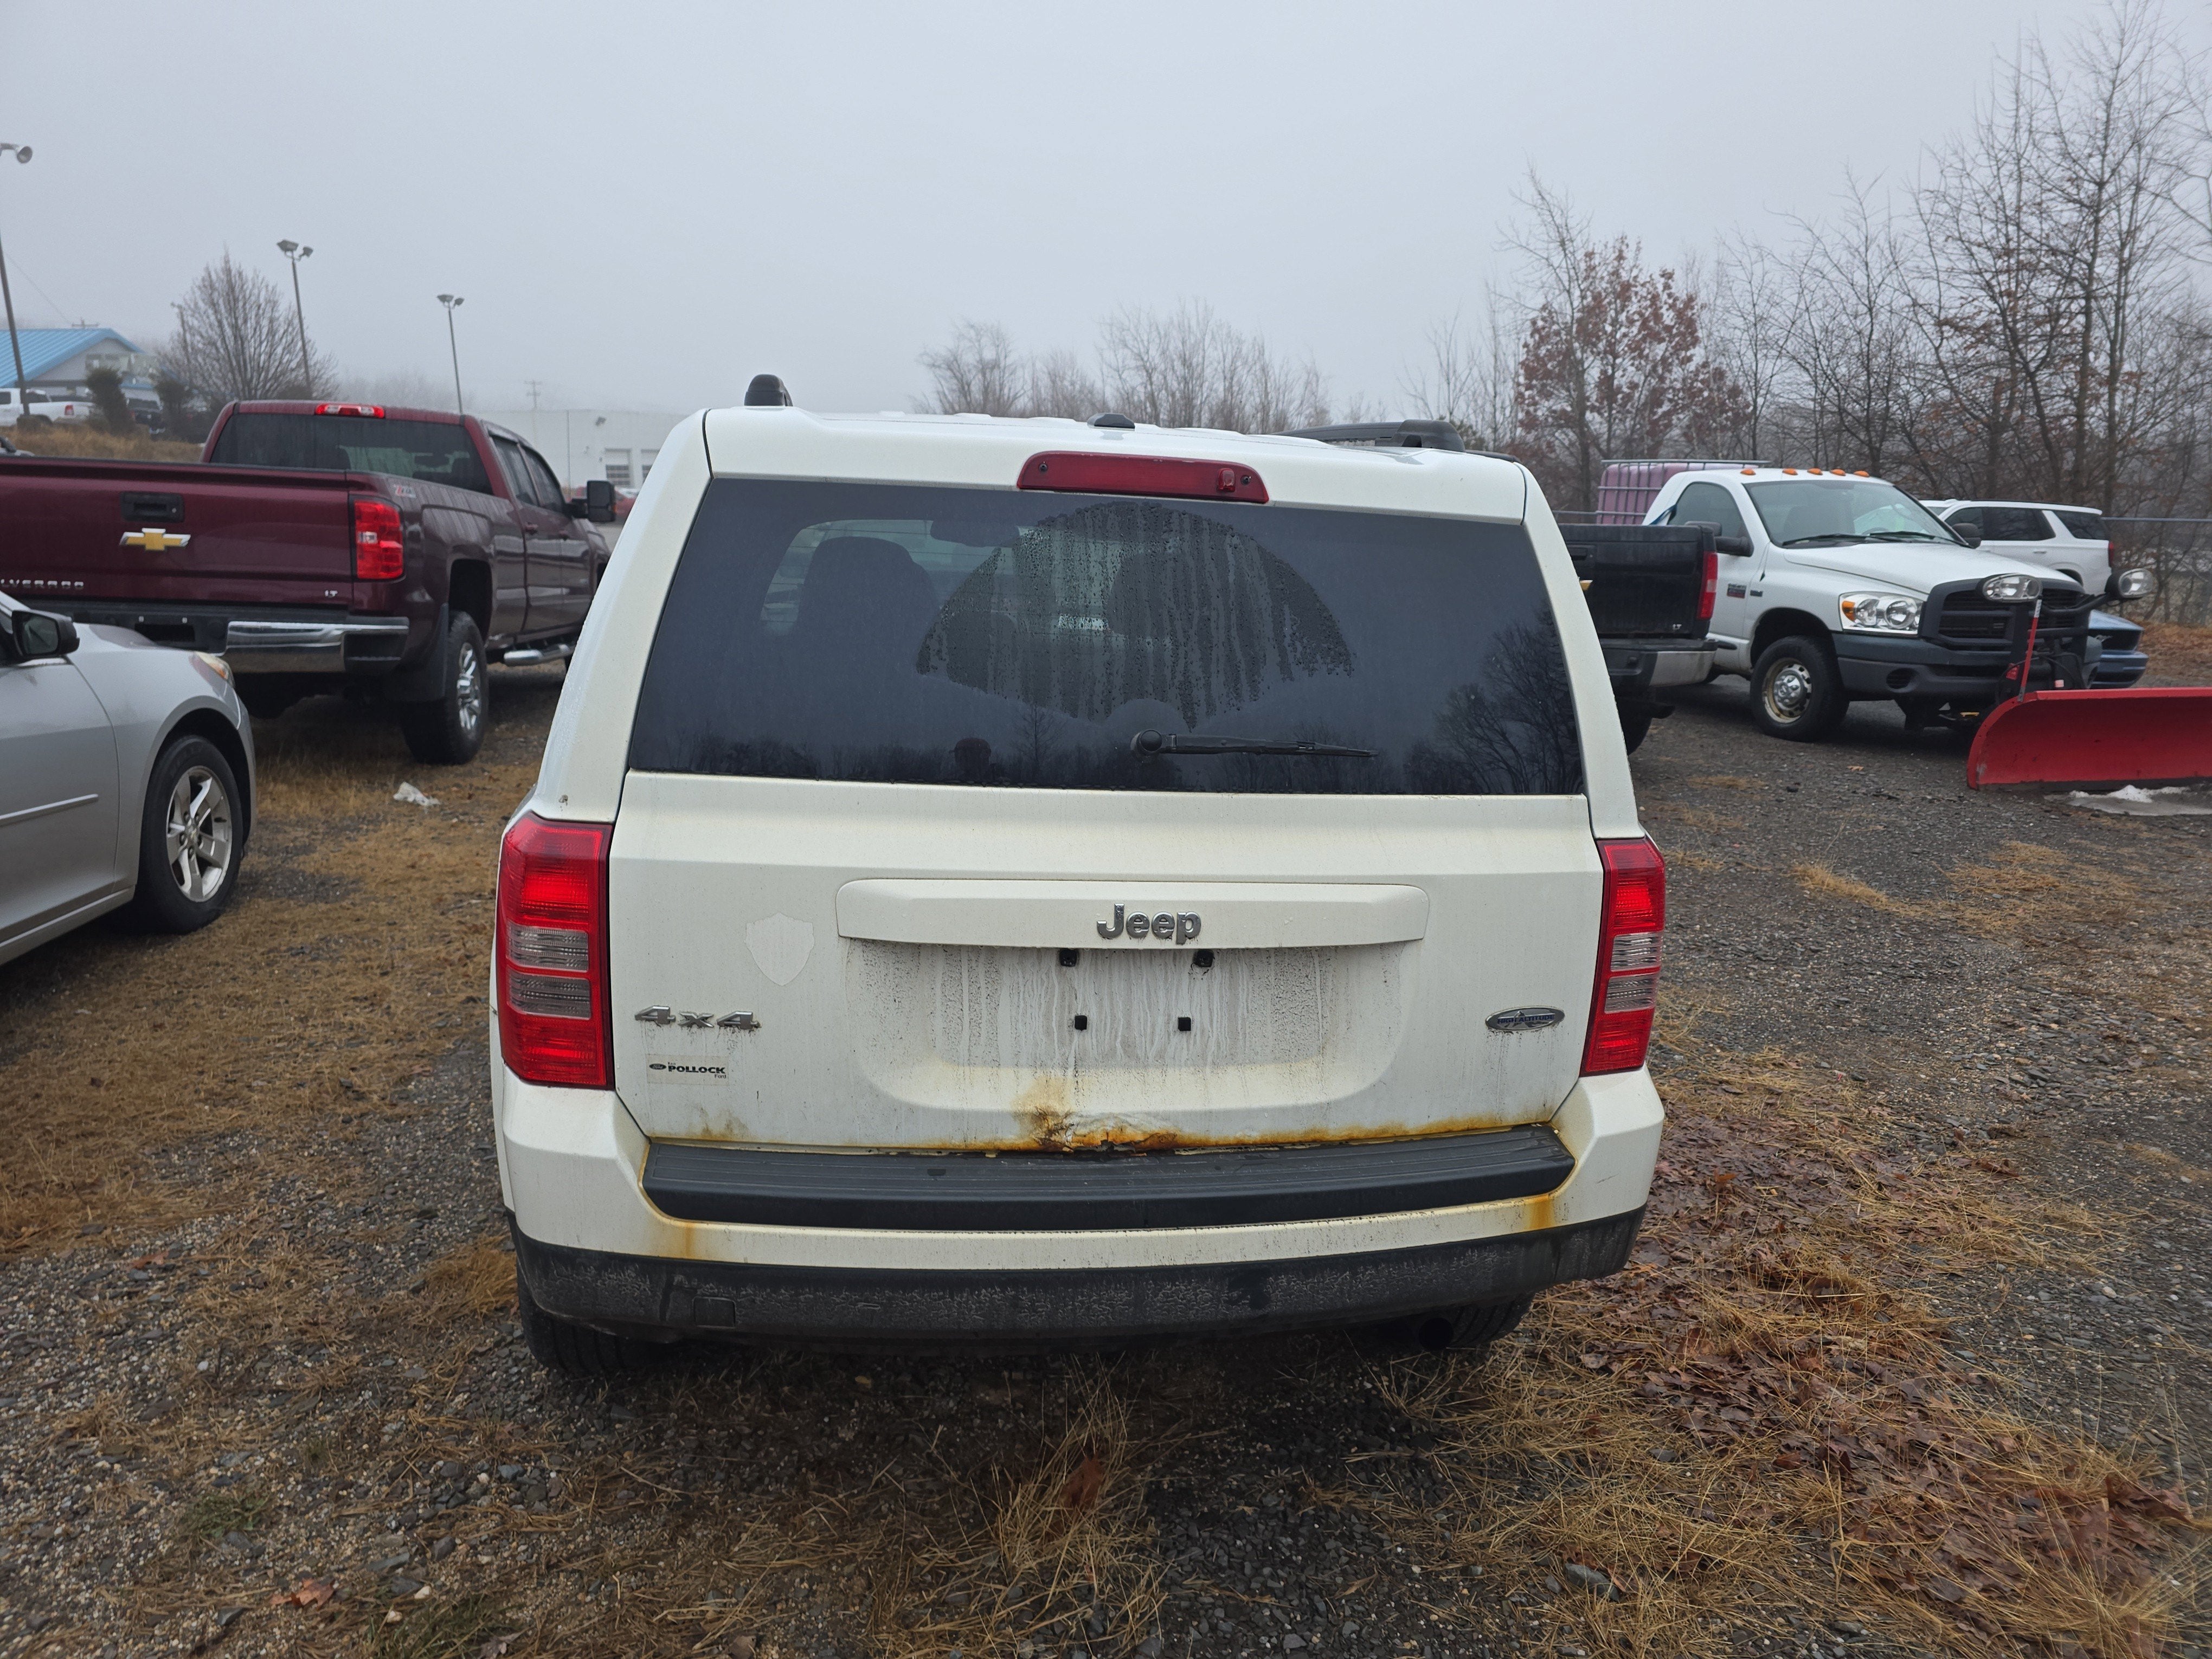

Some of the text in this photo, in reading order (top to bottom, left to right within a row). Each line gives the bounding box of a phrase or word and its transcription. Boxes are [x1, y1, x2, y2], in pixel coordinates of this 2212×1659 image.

[1096, 903, 1201, 946] Jeep
[634, 1005, 762, 1030] 4x4
[1517, 1014, 1555, 1023] ALTITUDE
[668, 1065, 725, 1073] POLLOCK
